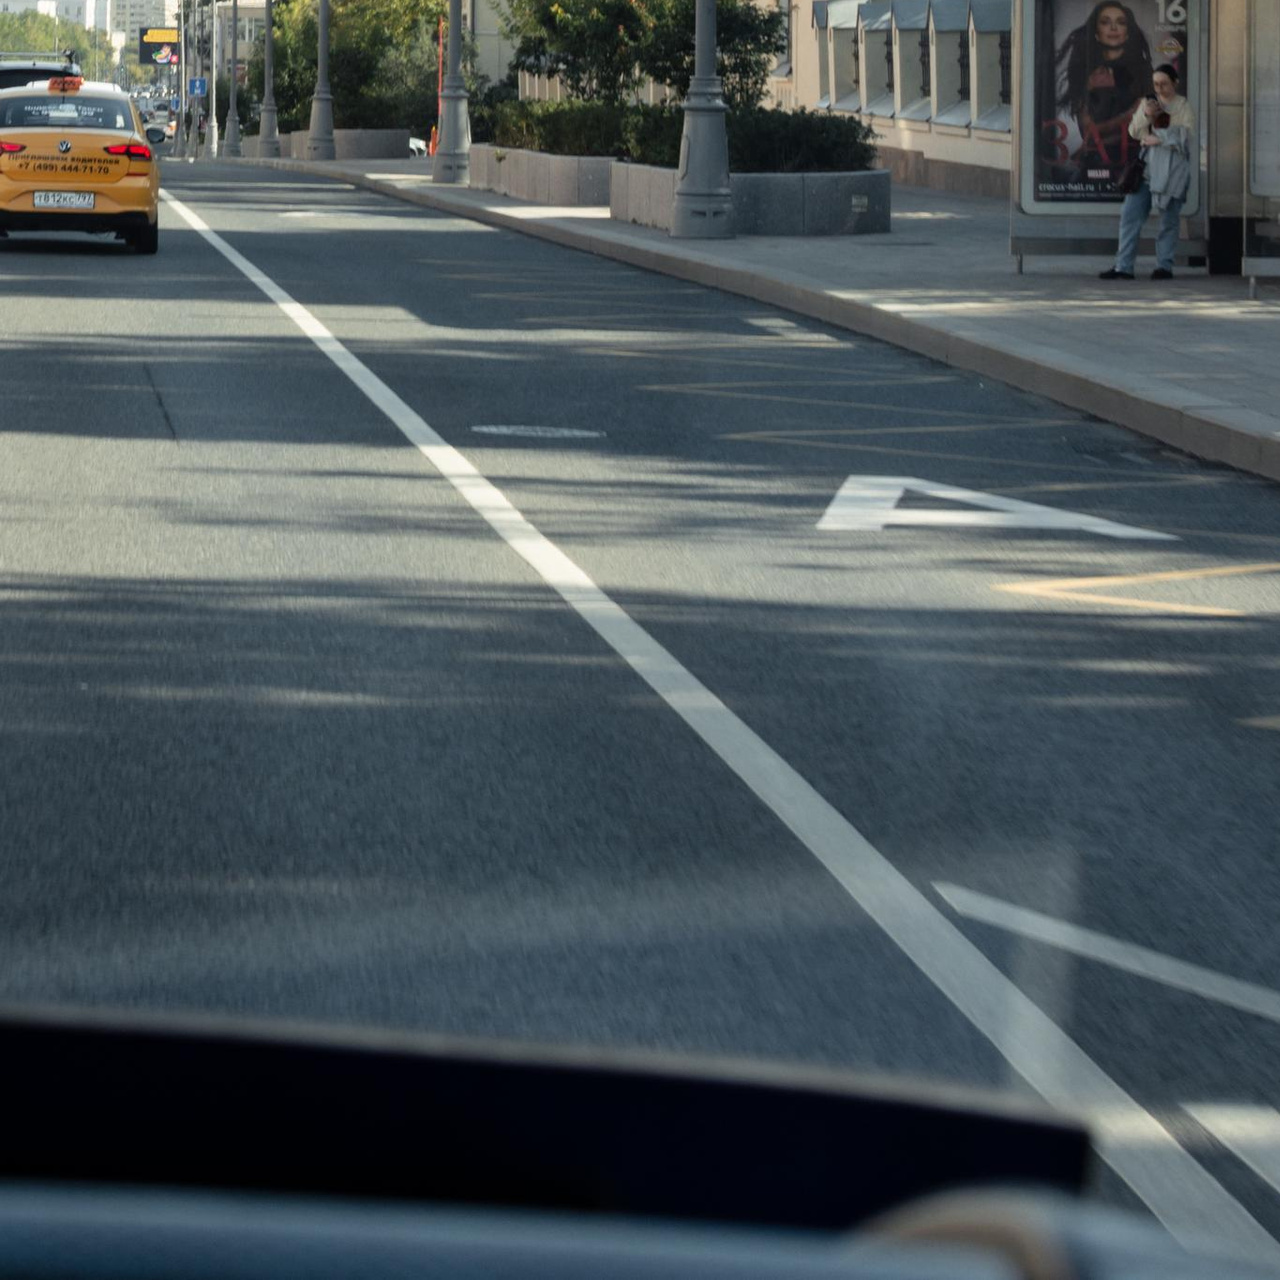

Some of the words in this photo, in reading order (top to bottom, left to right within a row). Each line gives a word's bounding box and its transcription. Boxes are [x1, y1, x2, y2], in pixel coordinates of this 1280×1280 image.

[18, 162, 30, 170] +7
[33, 163, 57, 173] (499)
[61, 164, 110, 174] 444-71-70
